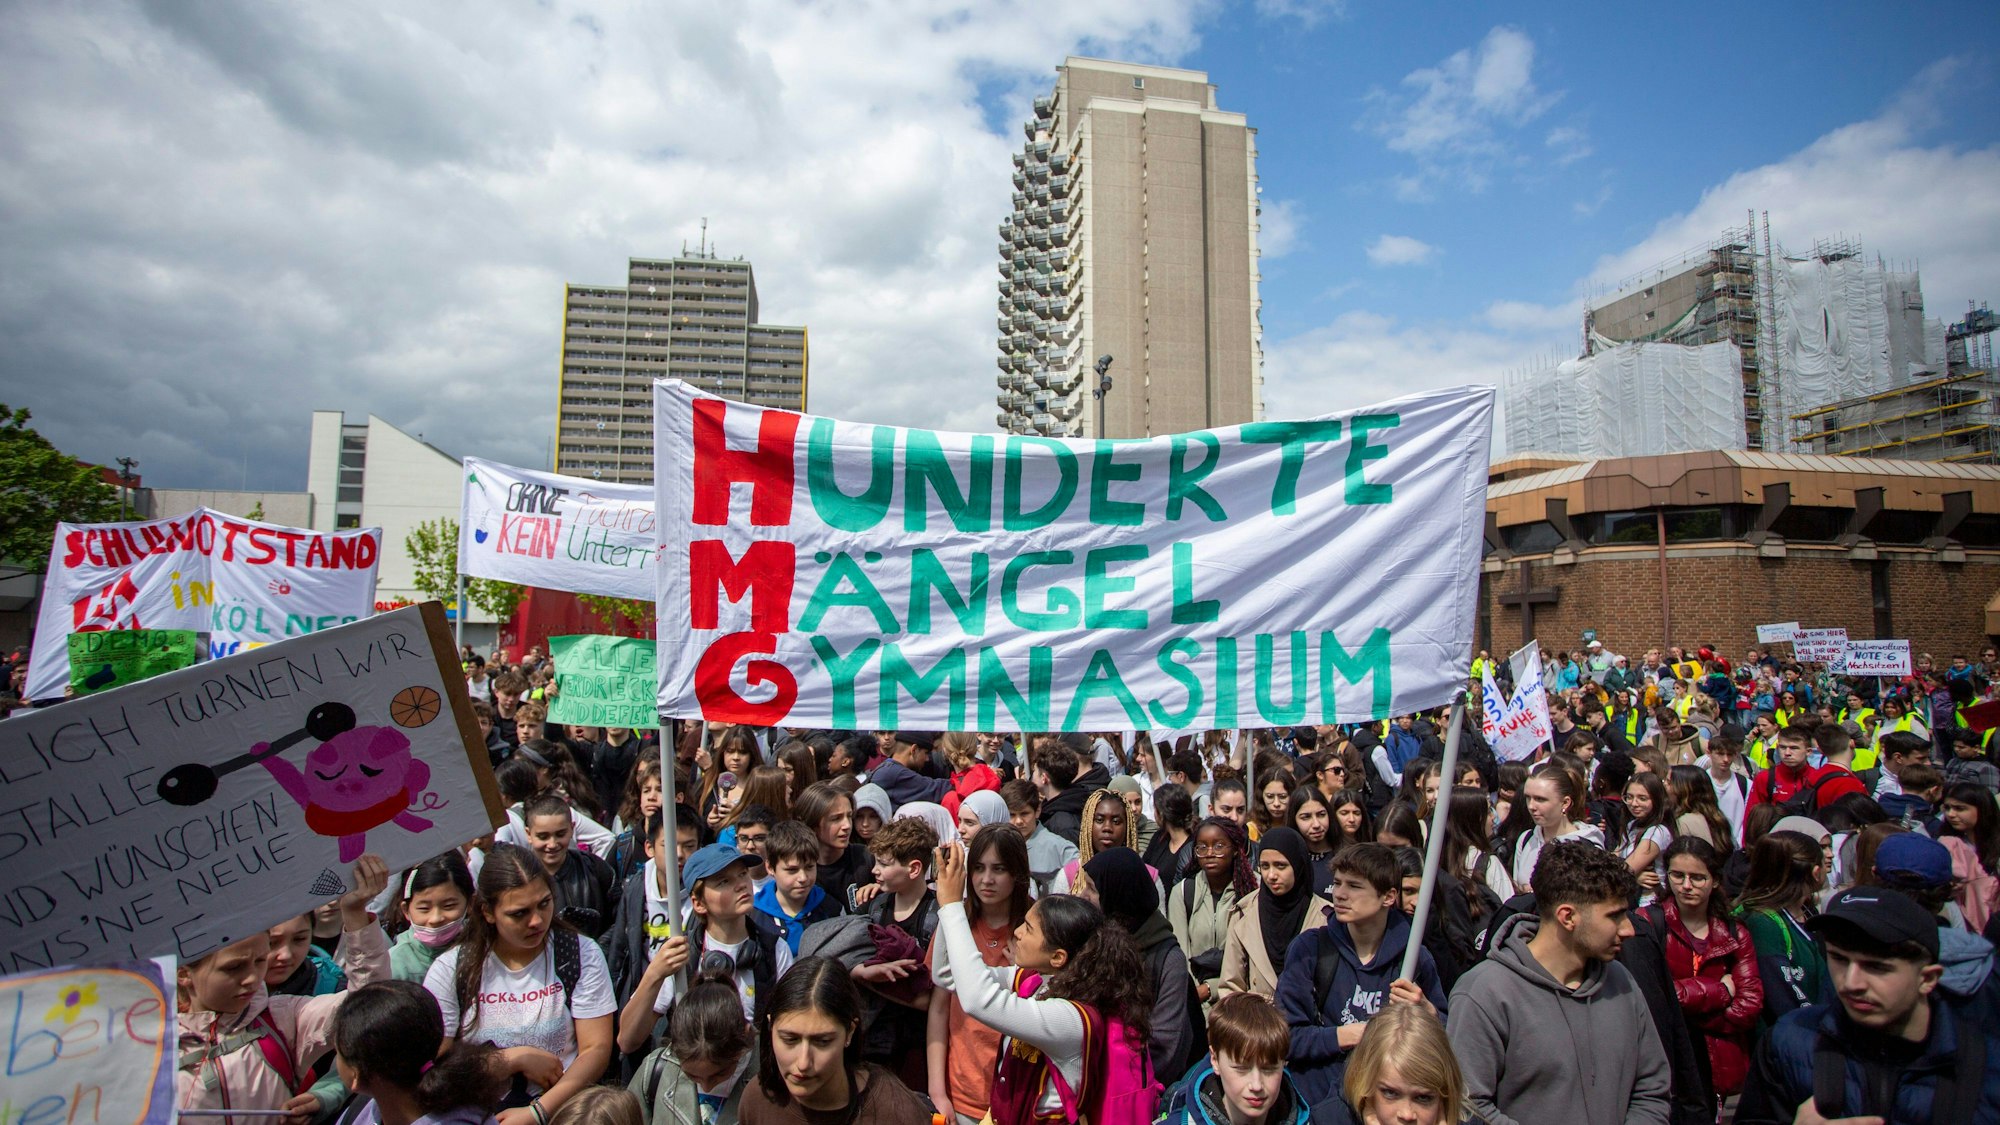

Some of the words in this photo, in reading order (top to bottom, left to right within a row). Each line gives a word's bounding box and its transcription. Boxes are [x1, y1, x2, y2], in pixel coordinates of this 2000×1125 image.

[693, 397, 1400, 532] HUNDERTE
[506, 482, 569, 516] OHNE
[64, 514, 377, 570] SCHULNOTSTAND
[496, 513, 562, 560] KEIN
[690, 538, 1221, 635] MÄNGEL
[210, 597, 359, 636] KÖLNE
[1793, 631, 1809, 640] WIR
[1826, 629, 1846, 637] HIER
[557, 643, 656, 674] ALLE
[694, 627, 1391, 732] GYMNASIUM
[147, 656, 324, 728] TURNEN
[336, 633, 422, 678] WIR
[554, 672, 657, 702] VERDRECK
[553, 698, 590, 723] UND
[591, 703, 660, 726] DEFEK
[1498, 707, 1537, 738] RUHE
[61, 792, 282, 901] WÜNSCHEN
[176, 832, 295, 905] NEUE
[478, 981, 564, 1004] ACK&JONES
